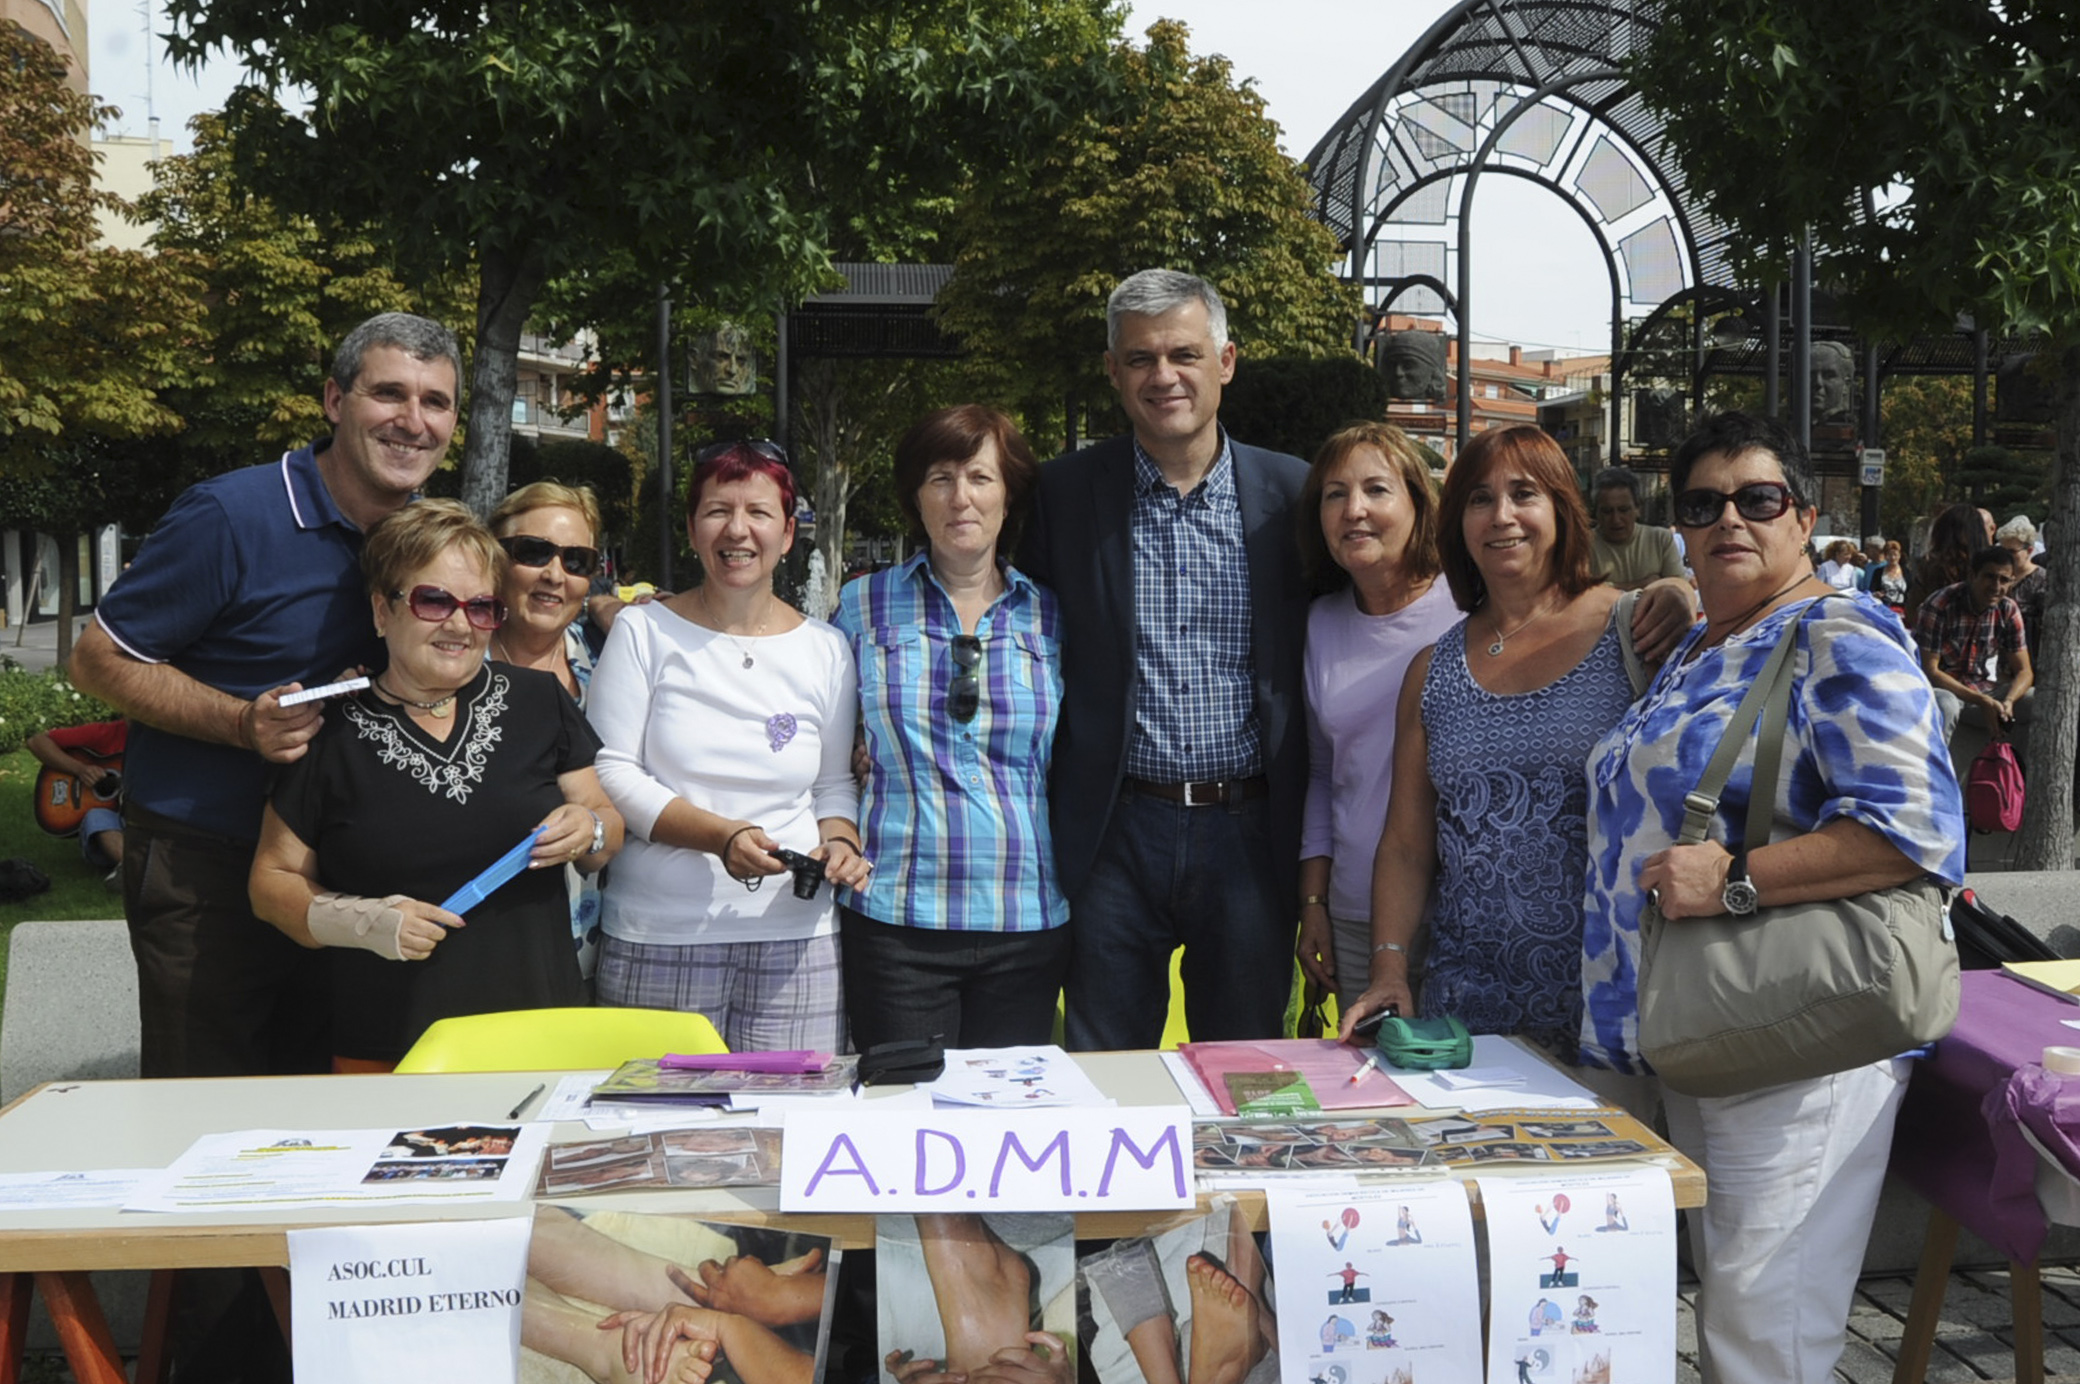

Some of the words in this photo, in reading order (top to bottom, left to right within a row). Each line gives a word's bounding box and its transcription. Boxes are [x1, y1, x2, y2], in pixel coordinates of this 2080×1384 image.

[804, 1125, 1187, 1198] A.D.M.M
[327, 1257, 432, 1281] ASOC.CUL
[328, 1296, 422, 1320] MADRID
[429, 1289, 521, 1313] ETERNO
